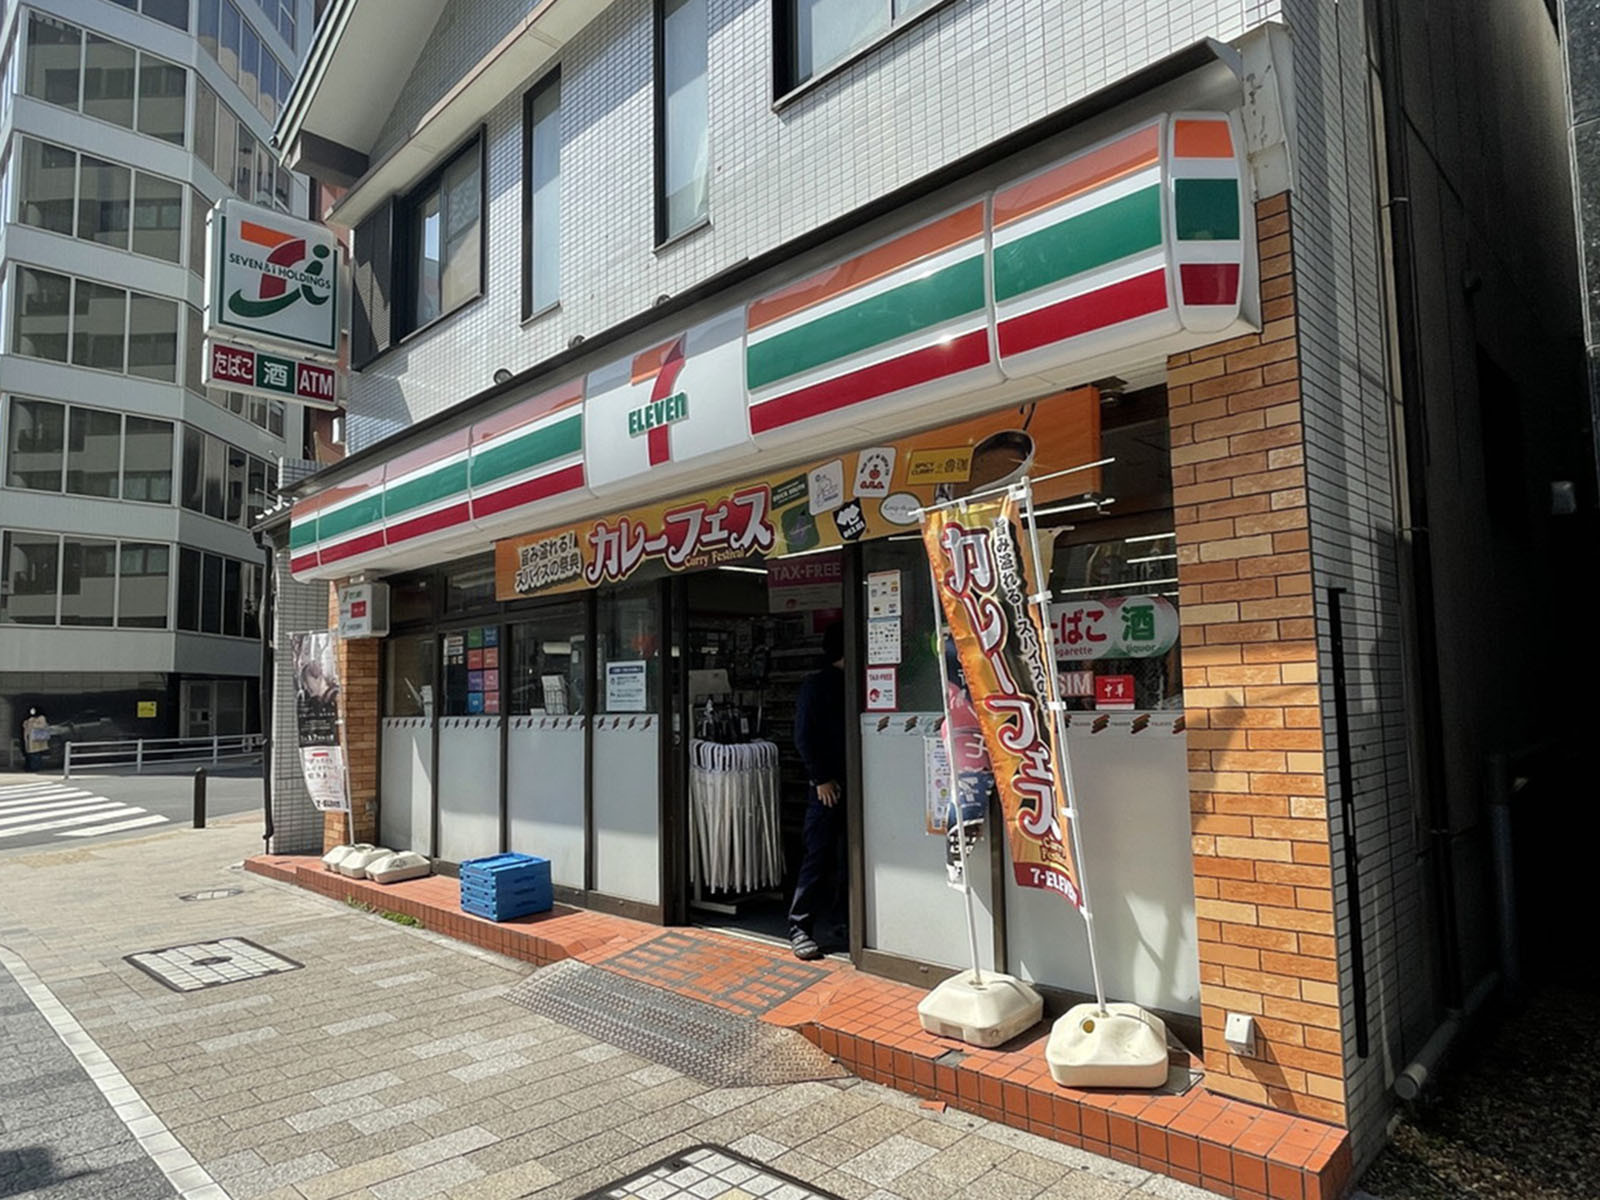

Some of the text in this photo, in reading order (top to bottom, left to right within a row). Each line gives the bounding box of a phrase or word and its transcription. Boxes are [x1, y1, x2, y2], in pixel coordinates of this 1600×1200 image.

[278, 266, 331, 290] HOLDINGS
[214, 351, 253, 379] たばこ
[263, 361, 288, 387] 酒
[299, 370, 333, 396] ATM
[586, 490, 773, 582] カレーフェス
[1121, 605, 1155, 641] 酒
